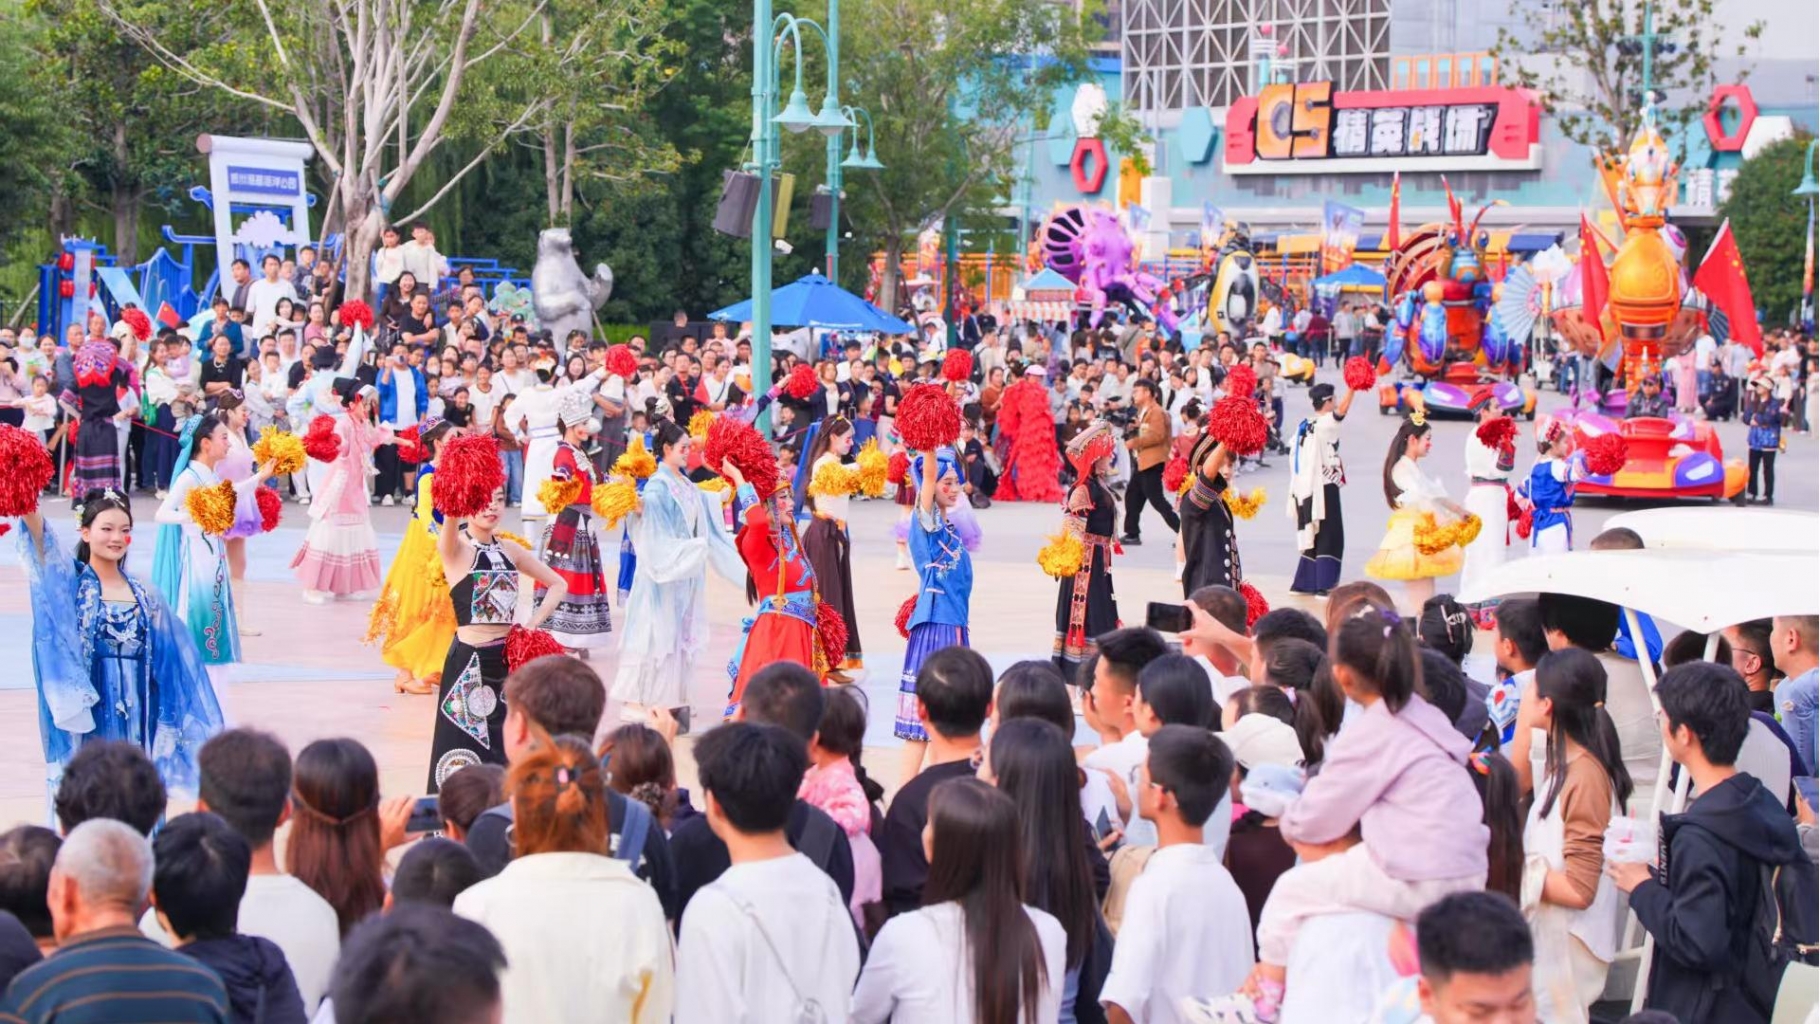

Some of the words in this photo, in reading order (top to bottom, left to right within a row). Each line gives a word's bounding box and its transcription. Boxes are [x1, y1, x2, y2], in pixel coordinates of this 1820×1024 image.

[1256, 80, 1332, 158] CS
[1333, 104, 1491, 157] 精英战场
